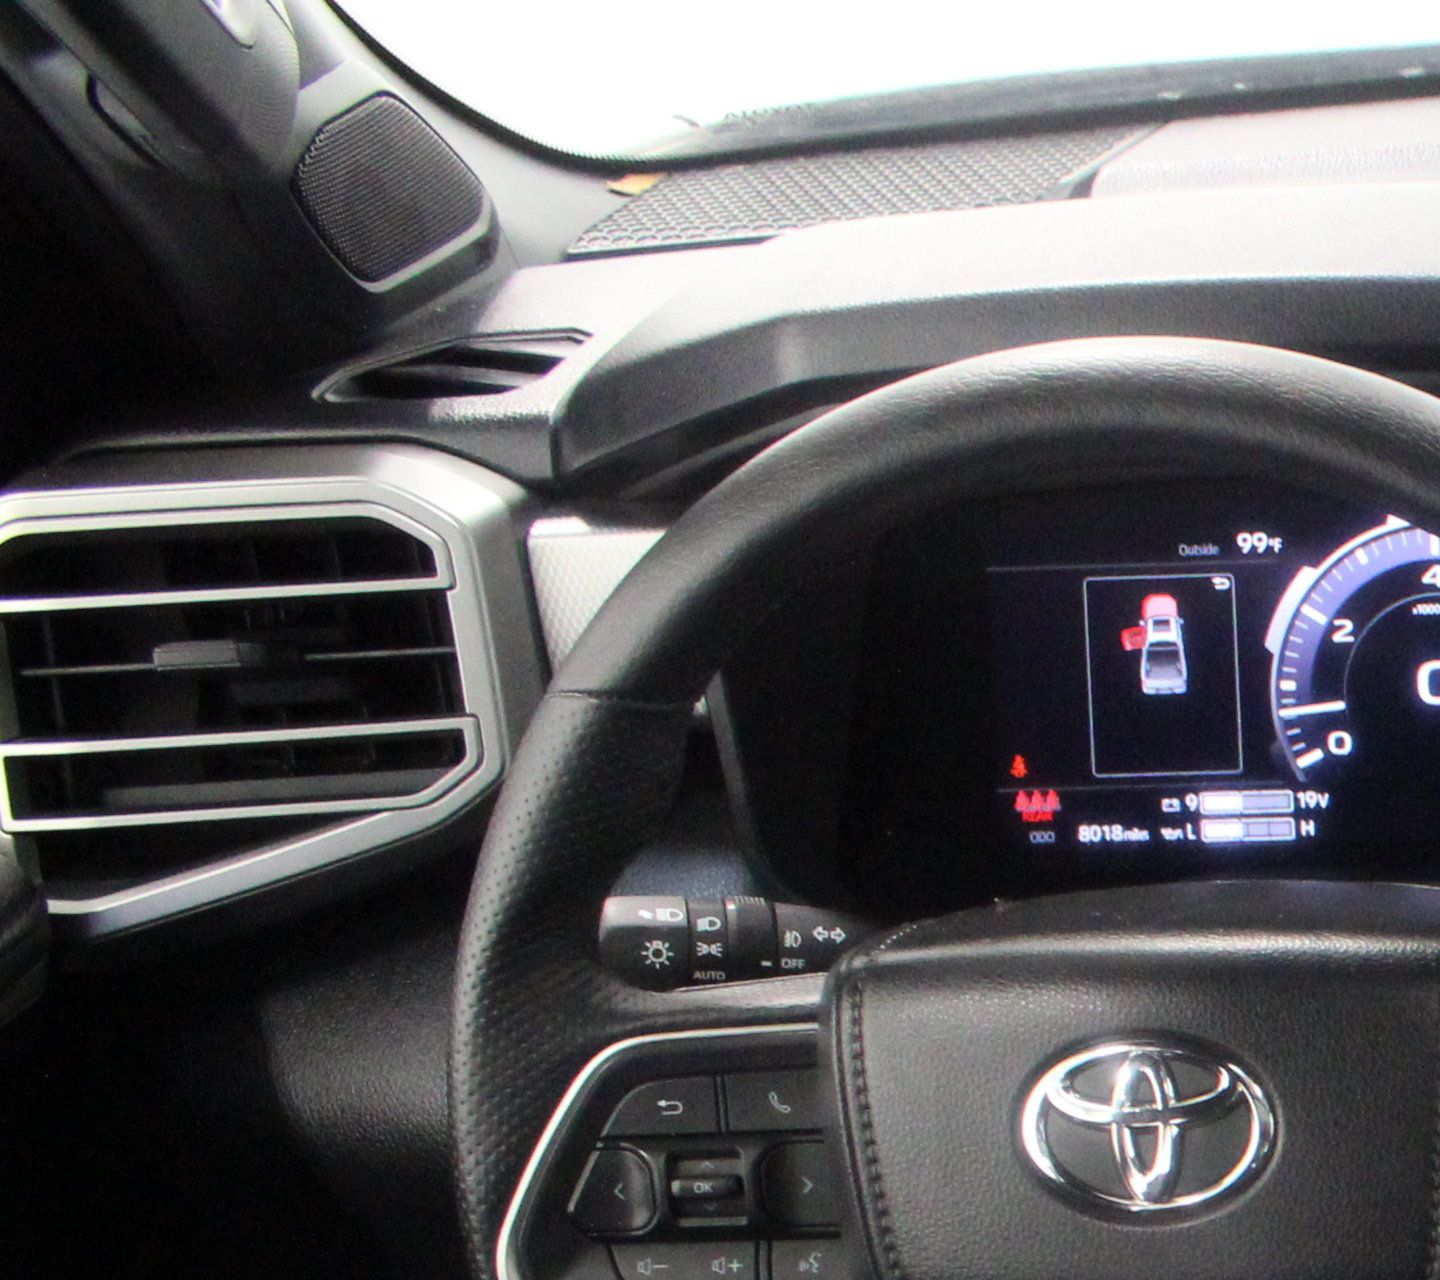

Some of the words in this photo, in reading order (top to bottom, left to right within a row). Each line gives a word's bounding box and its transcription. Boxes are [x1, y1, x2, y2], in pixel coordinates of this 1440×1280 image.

[1178, 543, 1221, 557] Outside
[1331, 619, 1355, 643] 2
[1326, 730, 1353, 756] 0
[1301, 819, 1315, 837] H
[781, 959, 806, 969] OFF
[692, 971, 726, 981] AUTO
[693, 1182, 713, 1194] OK
